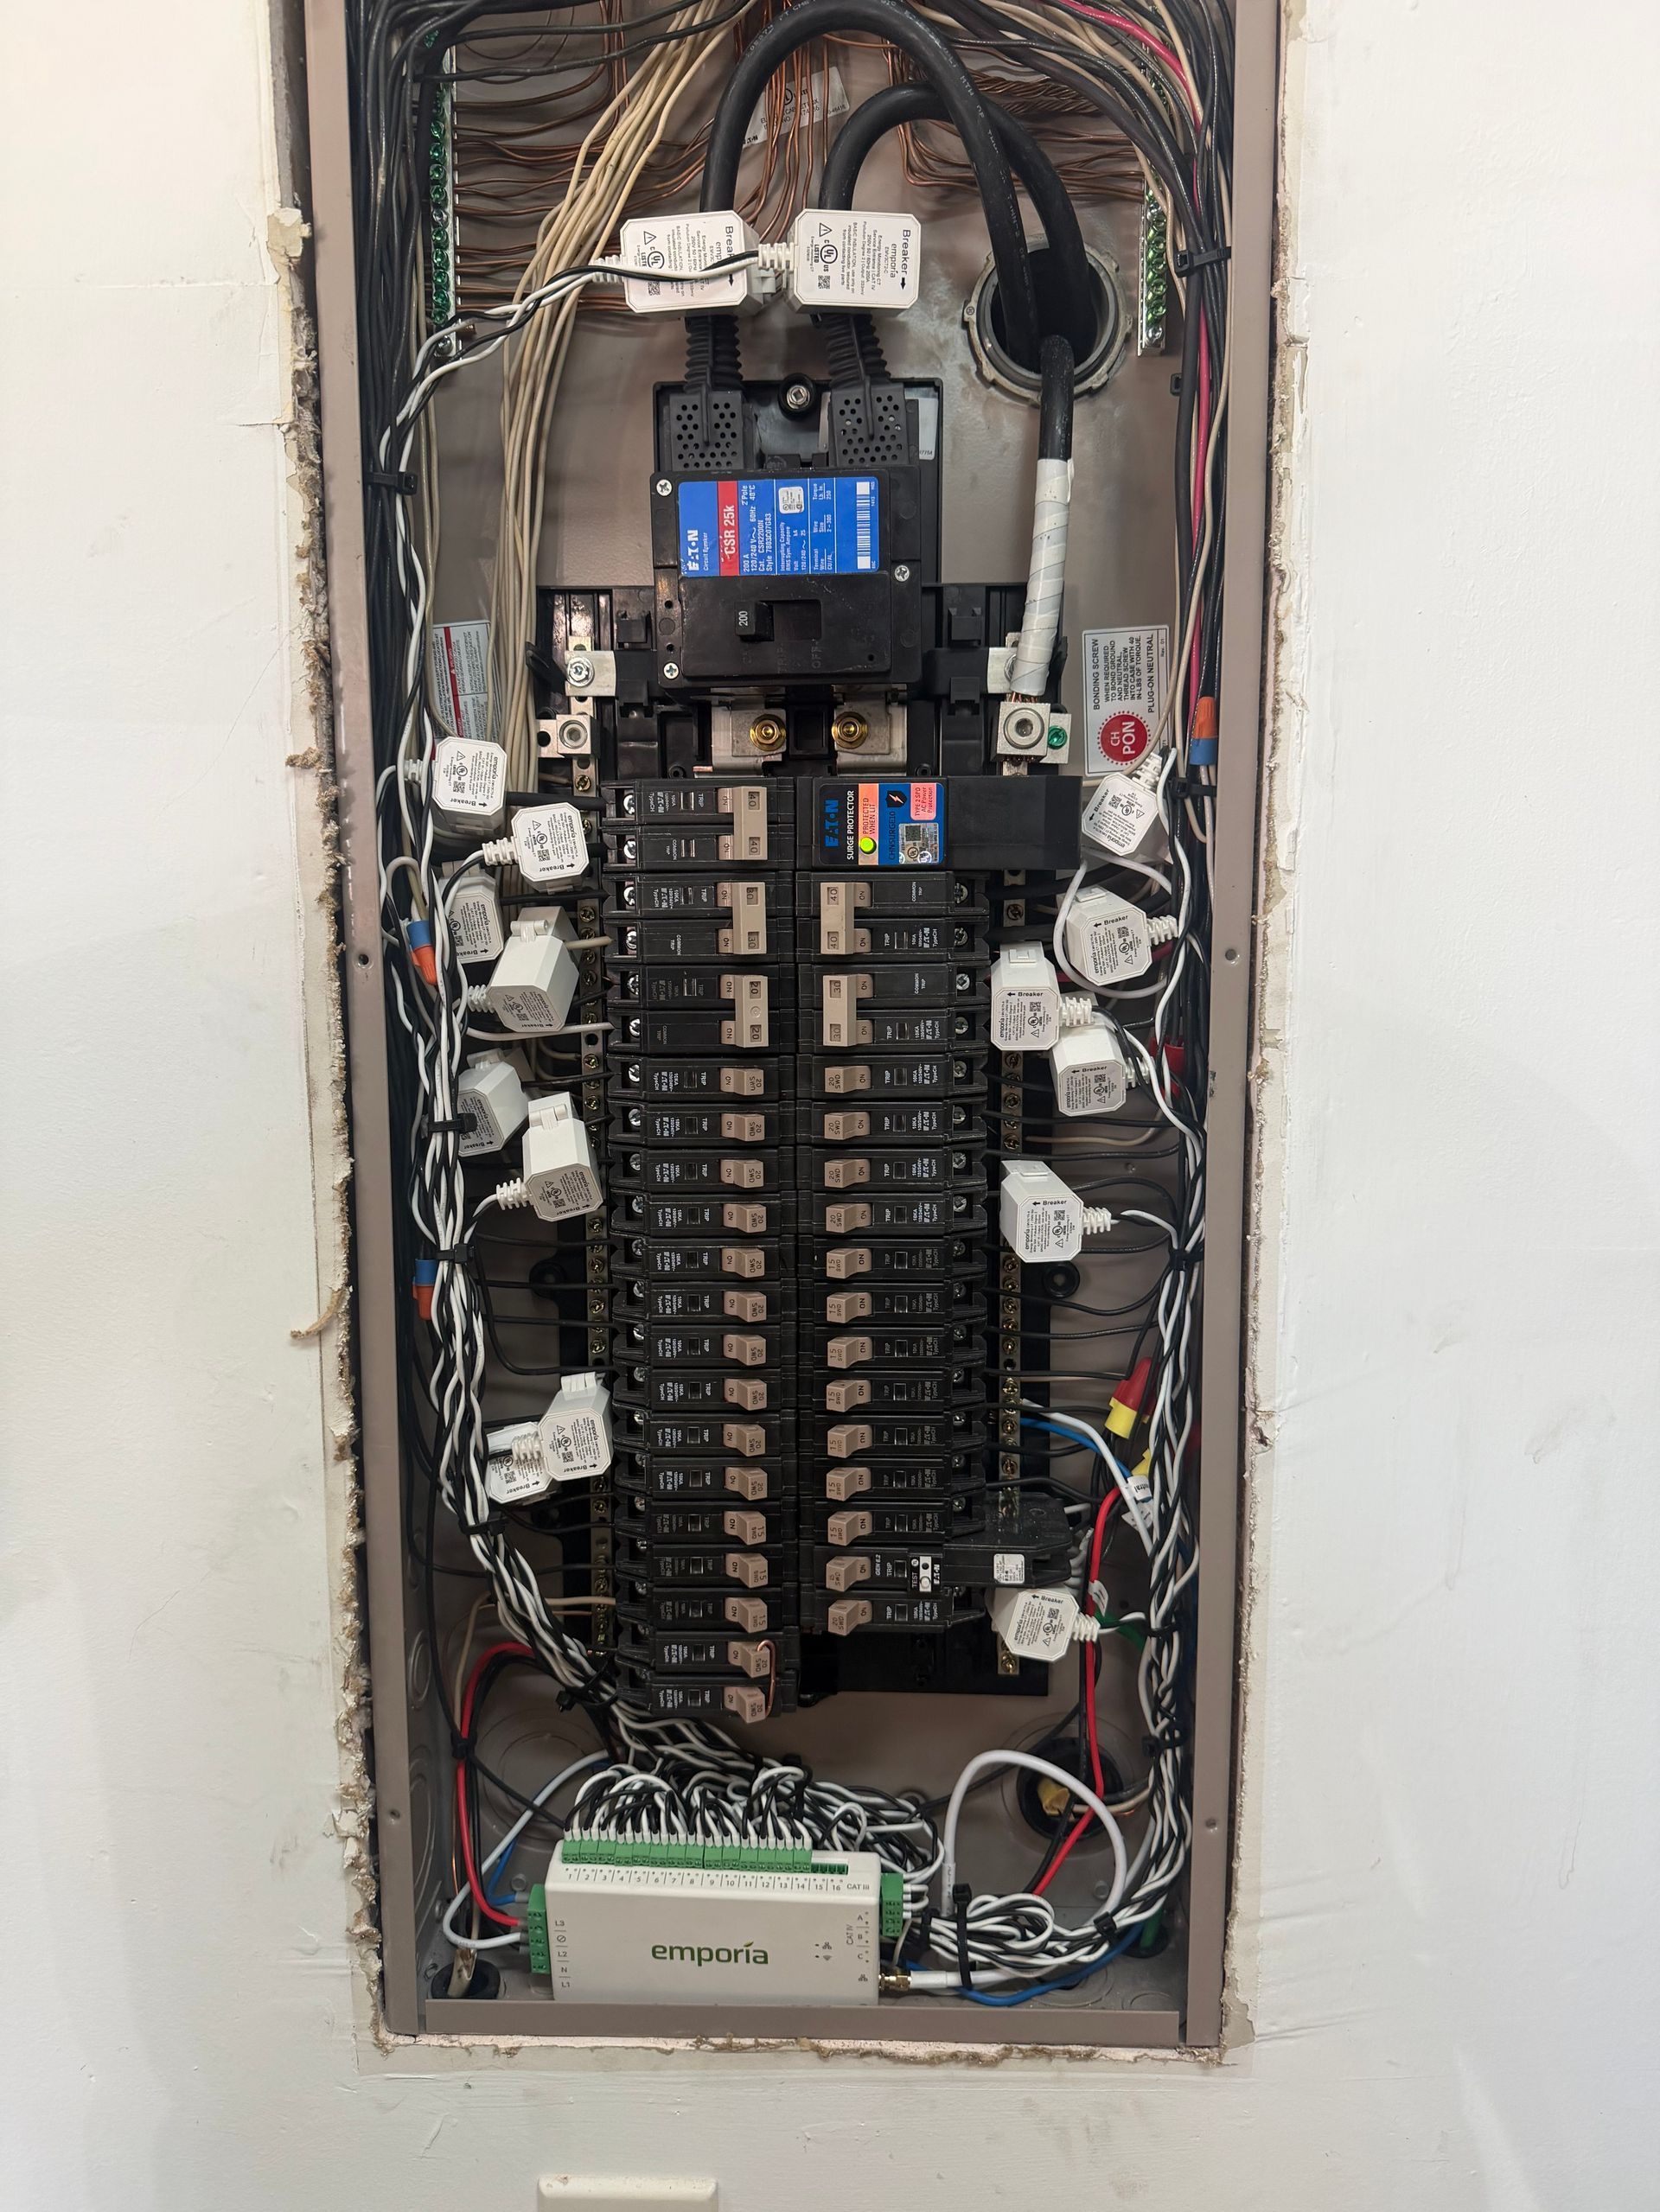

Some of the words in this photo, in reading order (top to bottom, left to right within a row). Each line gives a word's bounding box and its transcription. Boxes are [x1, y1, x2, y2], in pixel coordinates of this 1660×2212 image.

[725, 226, 734, 258] Break
[901, 230, 910, 274] Breaker
[724, 505, 735, 526] 25k
[725, 529, 736, 554] CSR
[738, 611, 748, 626] 200
[1135, 667, 1141, 676] OF
[1110, 692, 1116, 701] TO
[1110, 731, 1120, 746] CH
[1123, 721, 1135, 755] PON
[450, 797, 476, 806] Breaker
[749, 793, 757, 807] 40
[1094, 789, 1109, 813] Breaker
[922, 804, 926, 813] AC
[750, 839, 758, 854] 40
[539, 864, 565, 873] Breaker
[831, 889, 837, 902] 40
[859, 890, 865, 900] ON
[1103, 915, 1129, 926] Breaker
[830, 935, 837, 948] 40
[860, 937, 865, 947] ON
[726, 981, 732, 993] ON
[750, 981, 758, 995] 20
[828, 1076, 835, 1087] 20
[859, 1074, 865, 1083] ON
[727, 1121, 731, 1131] ON
[756, 1124, 762, 1133] 20
[729, 1211, 733, 1221] ON
[758, 1214, 763, 1224] 20
[828, 1259, 835, 1269] 15
[859, 1254, 865, 1265] ON
[730, 1299, 734, 1309] ON
[759, 1304, 764, 1314] 20
[564, 1464, 588, 1473] Breaker
[730, 1519, 735, 1529] ON
[757, 1526, 764, 1537] 15
[1040, 1595, 1064, 1604] Breaker
